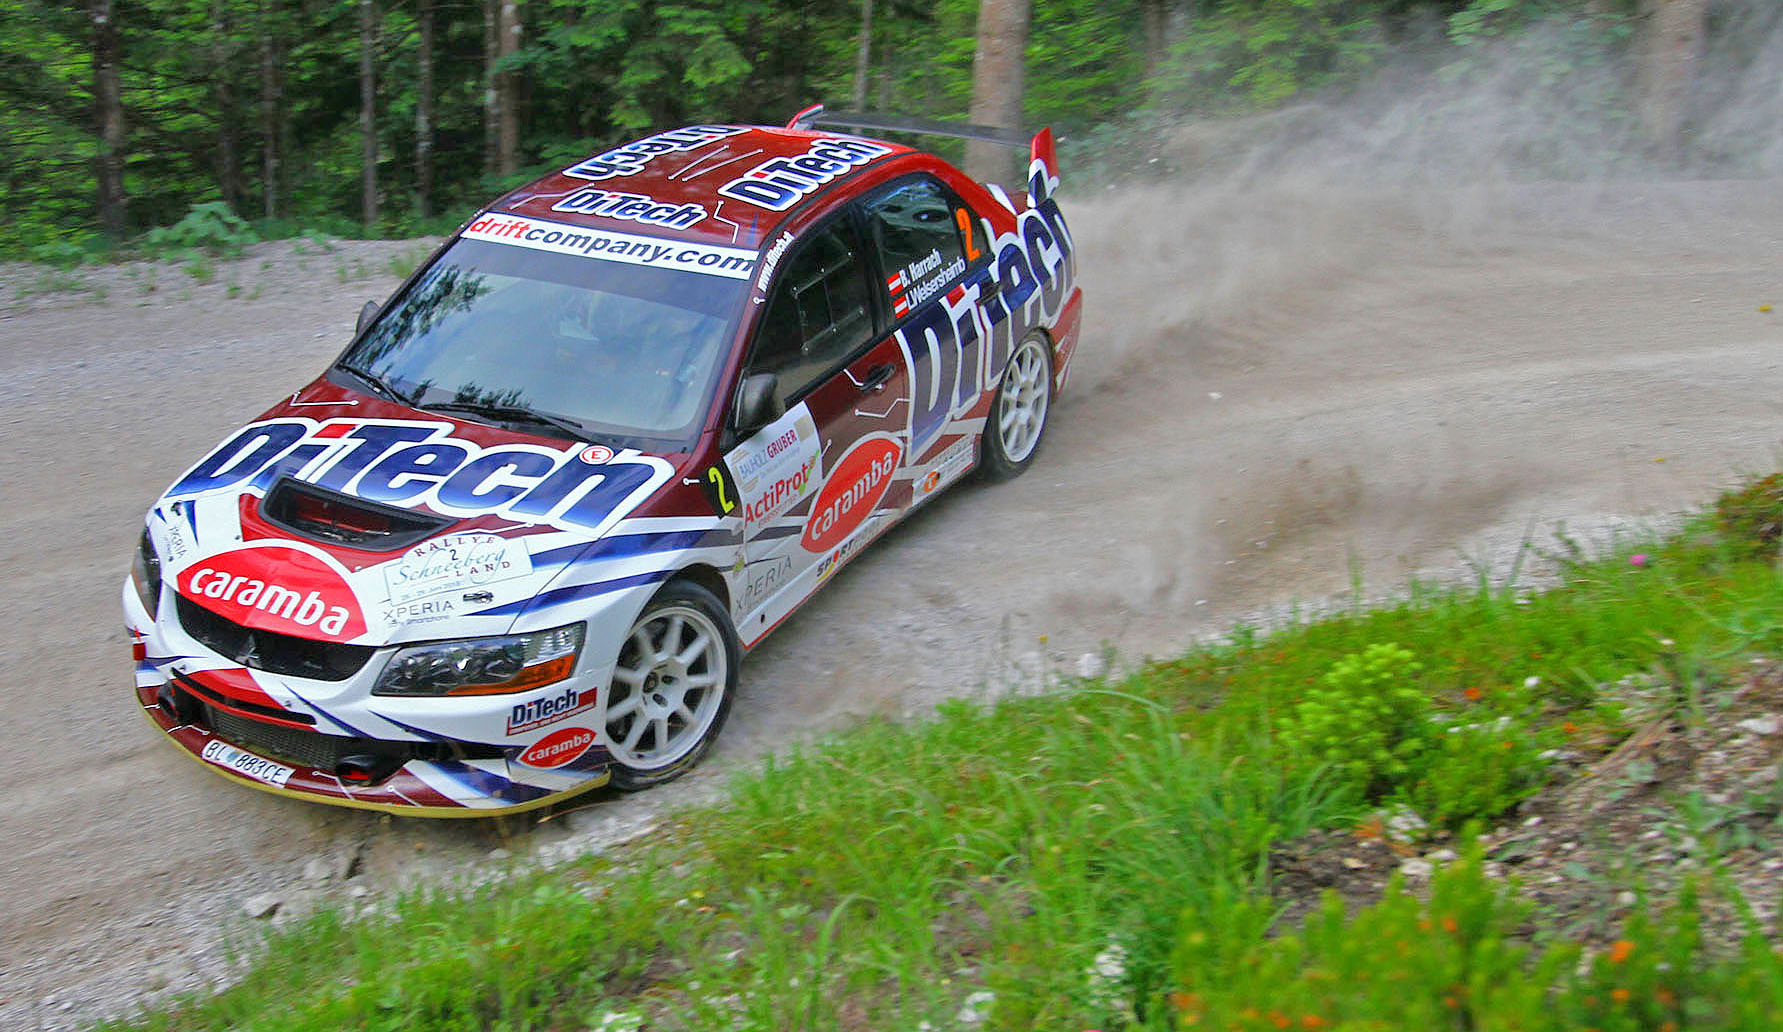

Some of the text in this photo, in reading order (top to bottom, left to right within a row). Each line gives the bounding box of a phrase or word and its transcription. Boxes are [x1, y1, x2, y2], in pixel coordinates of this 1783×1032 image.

[721, 139, 890, 210] DiTech
[557, 188, 705, 230] DiTech
[470, 218, 756, 273] driftcompany.com
[955, 208, 982, 262] 2
[899, 248, 942, 288] B. Harrach
[767, 429, 798, 458] GRUBER
[160, 419, 665, 533] DiTech
[708, 467, 735, 514] 2
[744, 463, 809, 529] ActiProt
[811, 450, 893, 541] caramba
[393, 543, 506, 585] Schneeberg
[416, 536, 495, 557] RALLYE
[450, 549, 458, 561] 2
[455, 561, 511, 577] LAND
[190, 568, 350, 635] caramba
[383, 600, 454, 620] XPERIA
[512, 689, 577, 726] DiTech
[206, 741, 286, 785] BL 883CE
[527, 733, 591, 761] caramba
